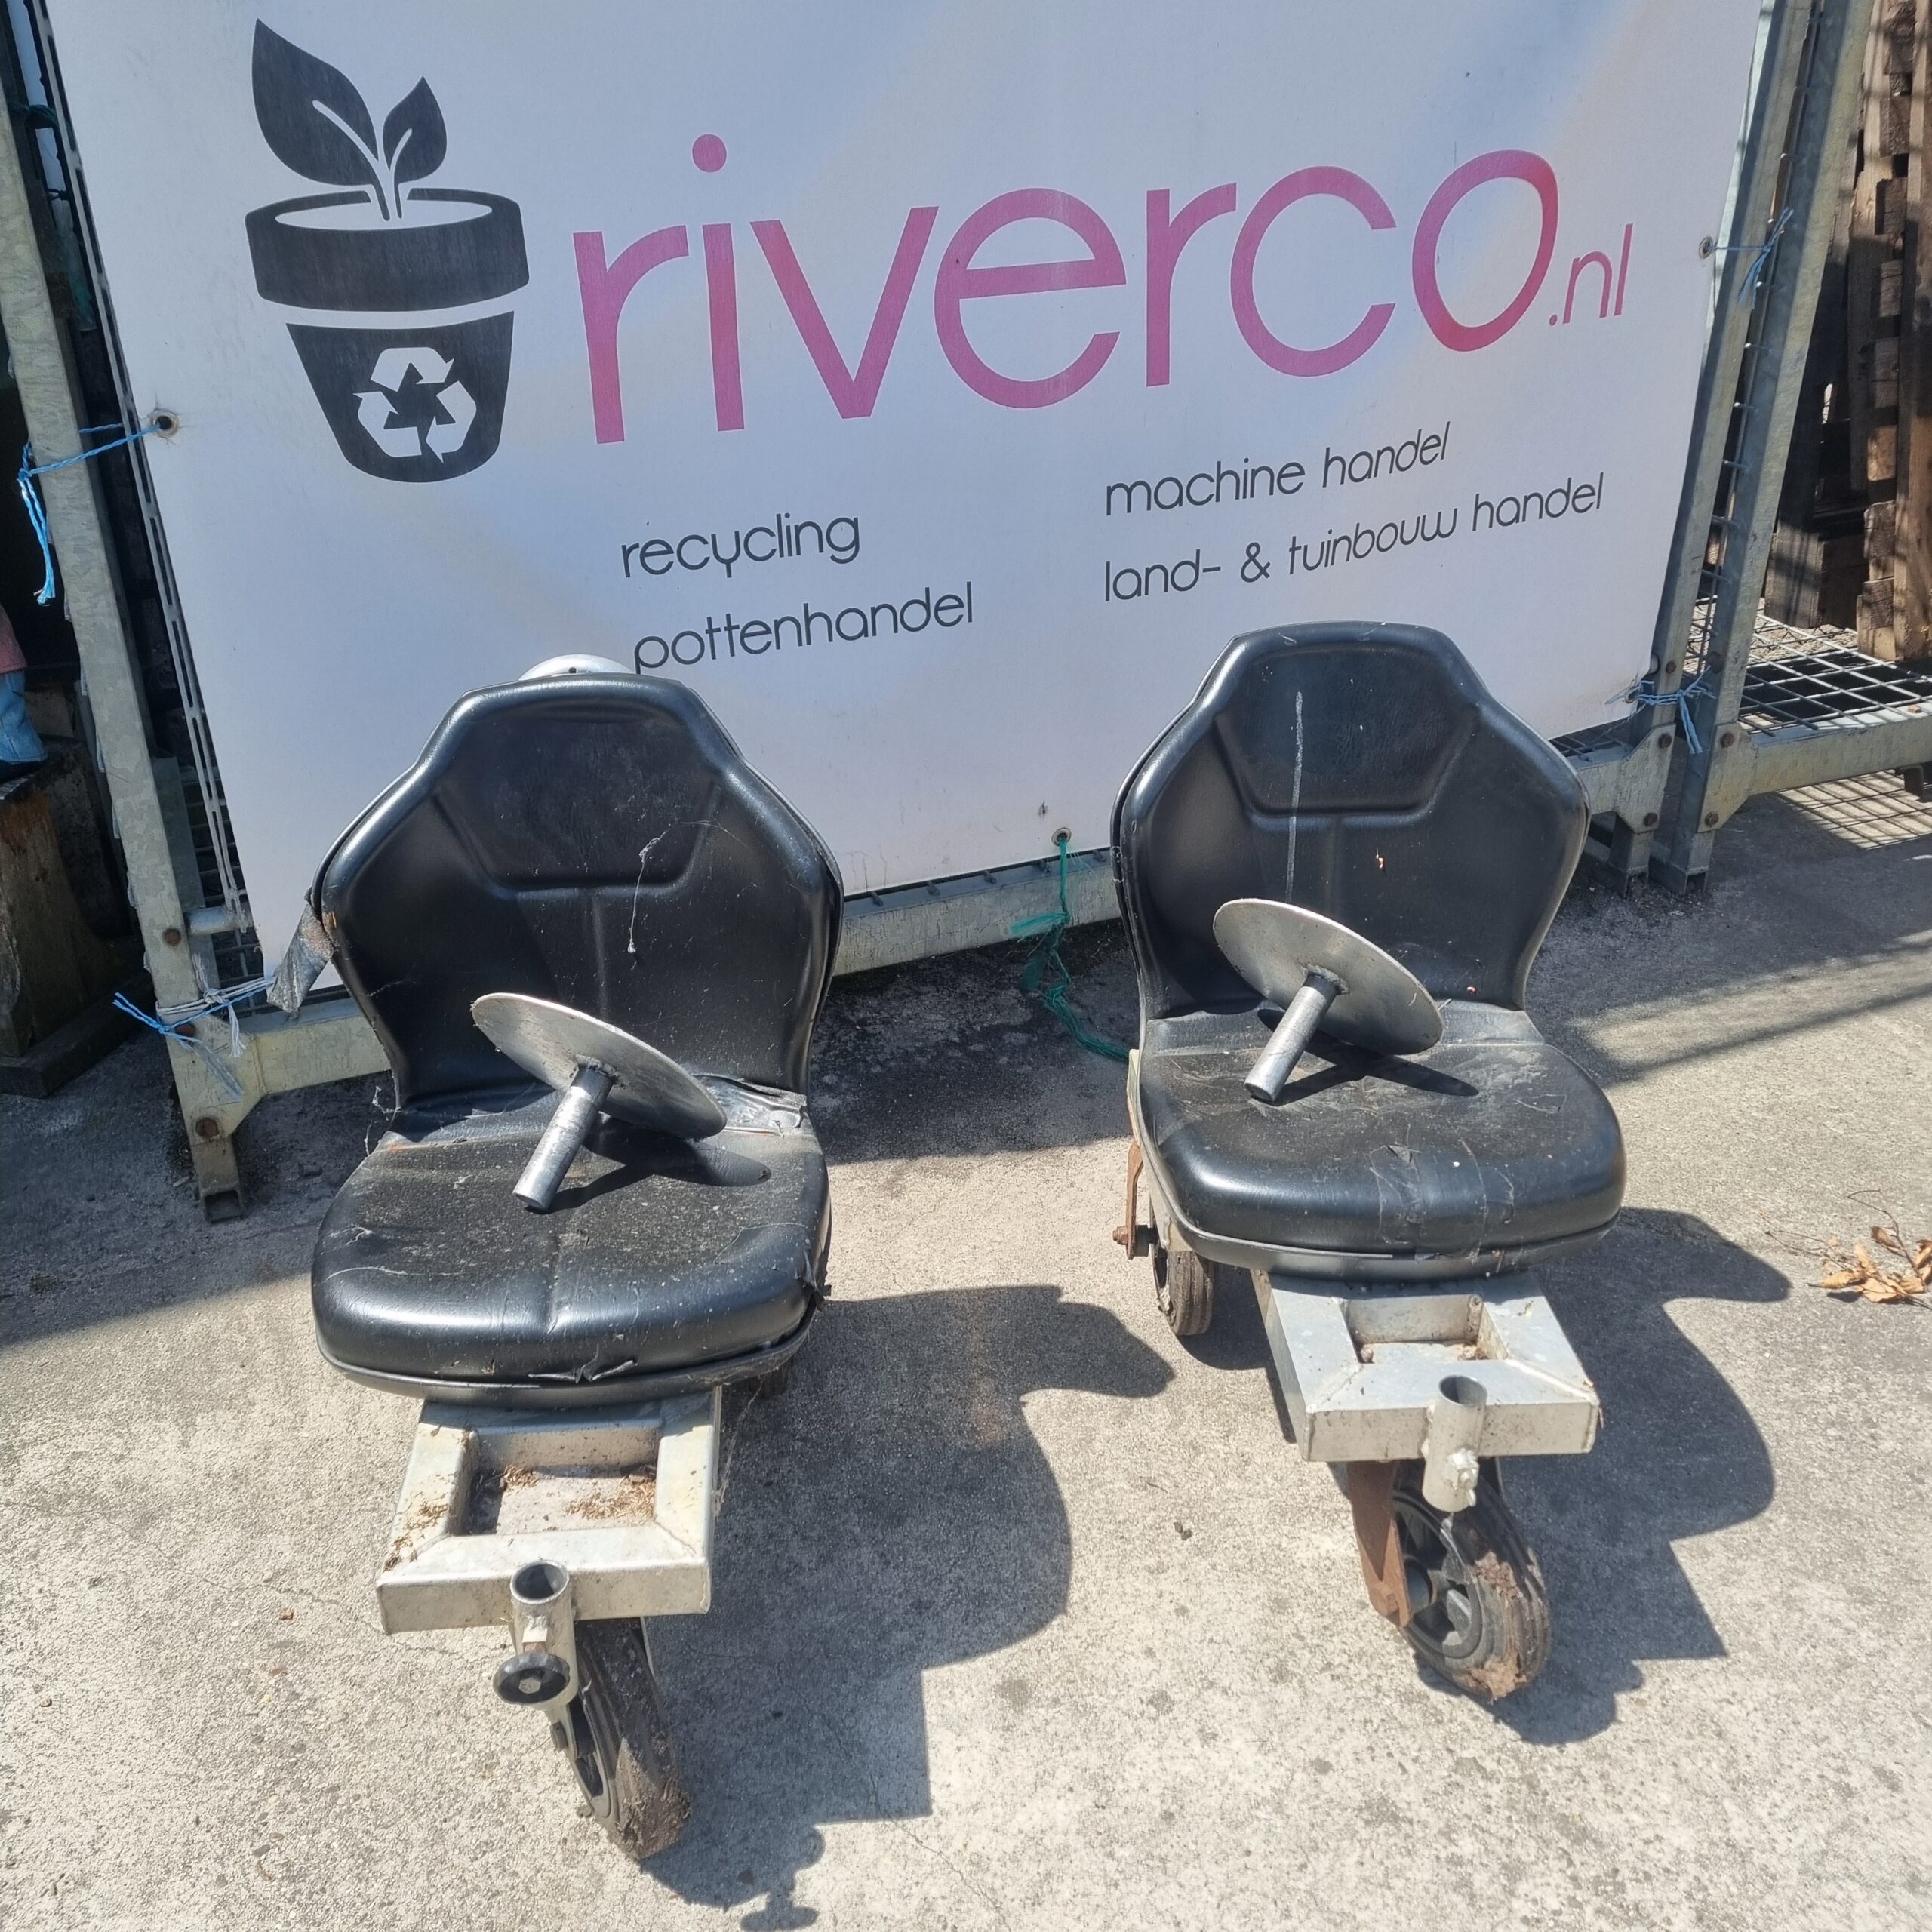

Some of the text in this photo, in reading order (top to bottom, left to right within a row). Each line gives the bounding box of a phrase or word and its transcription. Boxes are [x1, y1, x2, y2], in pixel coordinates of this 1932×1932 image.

[572, 134, 1633, 444] riverco.nl
[1106, 421, 1450, 516] machine handel
[620, 513, 861, 578] recycling
[1105, 472, 1604, 601] land- & tuinbouw handel
[634, 581, 974, 674] pottenhandel
